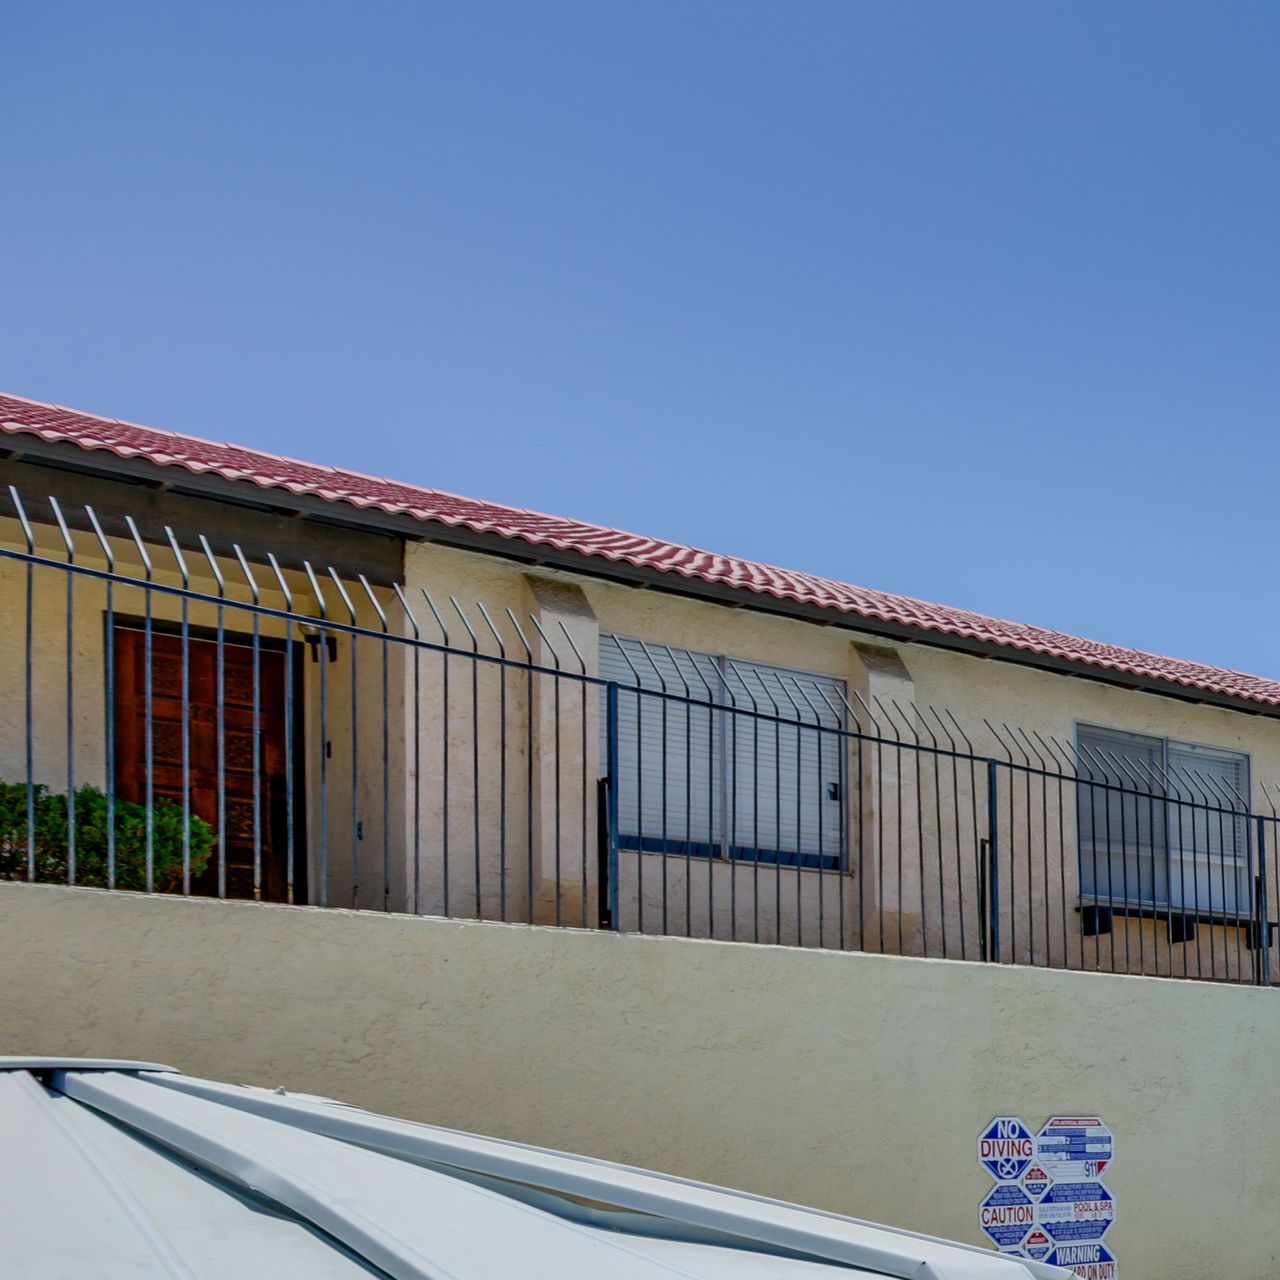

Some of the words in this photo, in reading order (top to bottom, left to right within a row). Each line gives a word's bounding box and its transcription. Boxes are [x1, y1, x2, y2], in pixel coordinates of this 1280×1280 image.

[997, 1120, 1019, 1138] NO
[981, 1140, 1032, 1157] DIVING
[1084, 1161, 1097, 1178] 911
[981, 1206, 1033, 1224] CAUTION
[1074, 1203, 1092, 1212] POOL
[1100, 1201, 1112, 1211] SPA
[1056, 1245, 1100, 1265] WARNING
[1088, 1264, 1097, 1280] ON
[1099, 1263, 1115, 1279] DUTY
